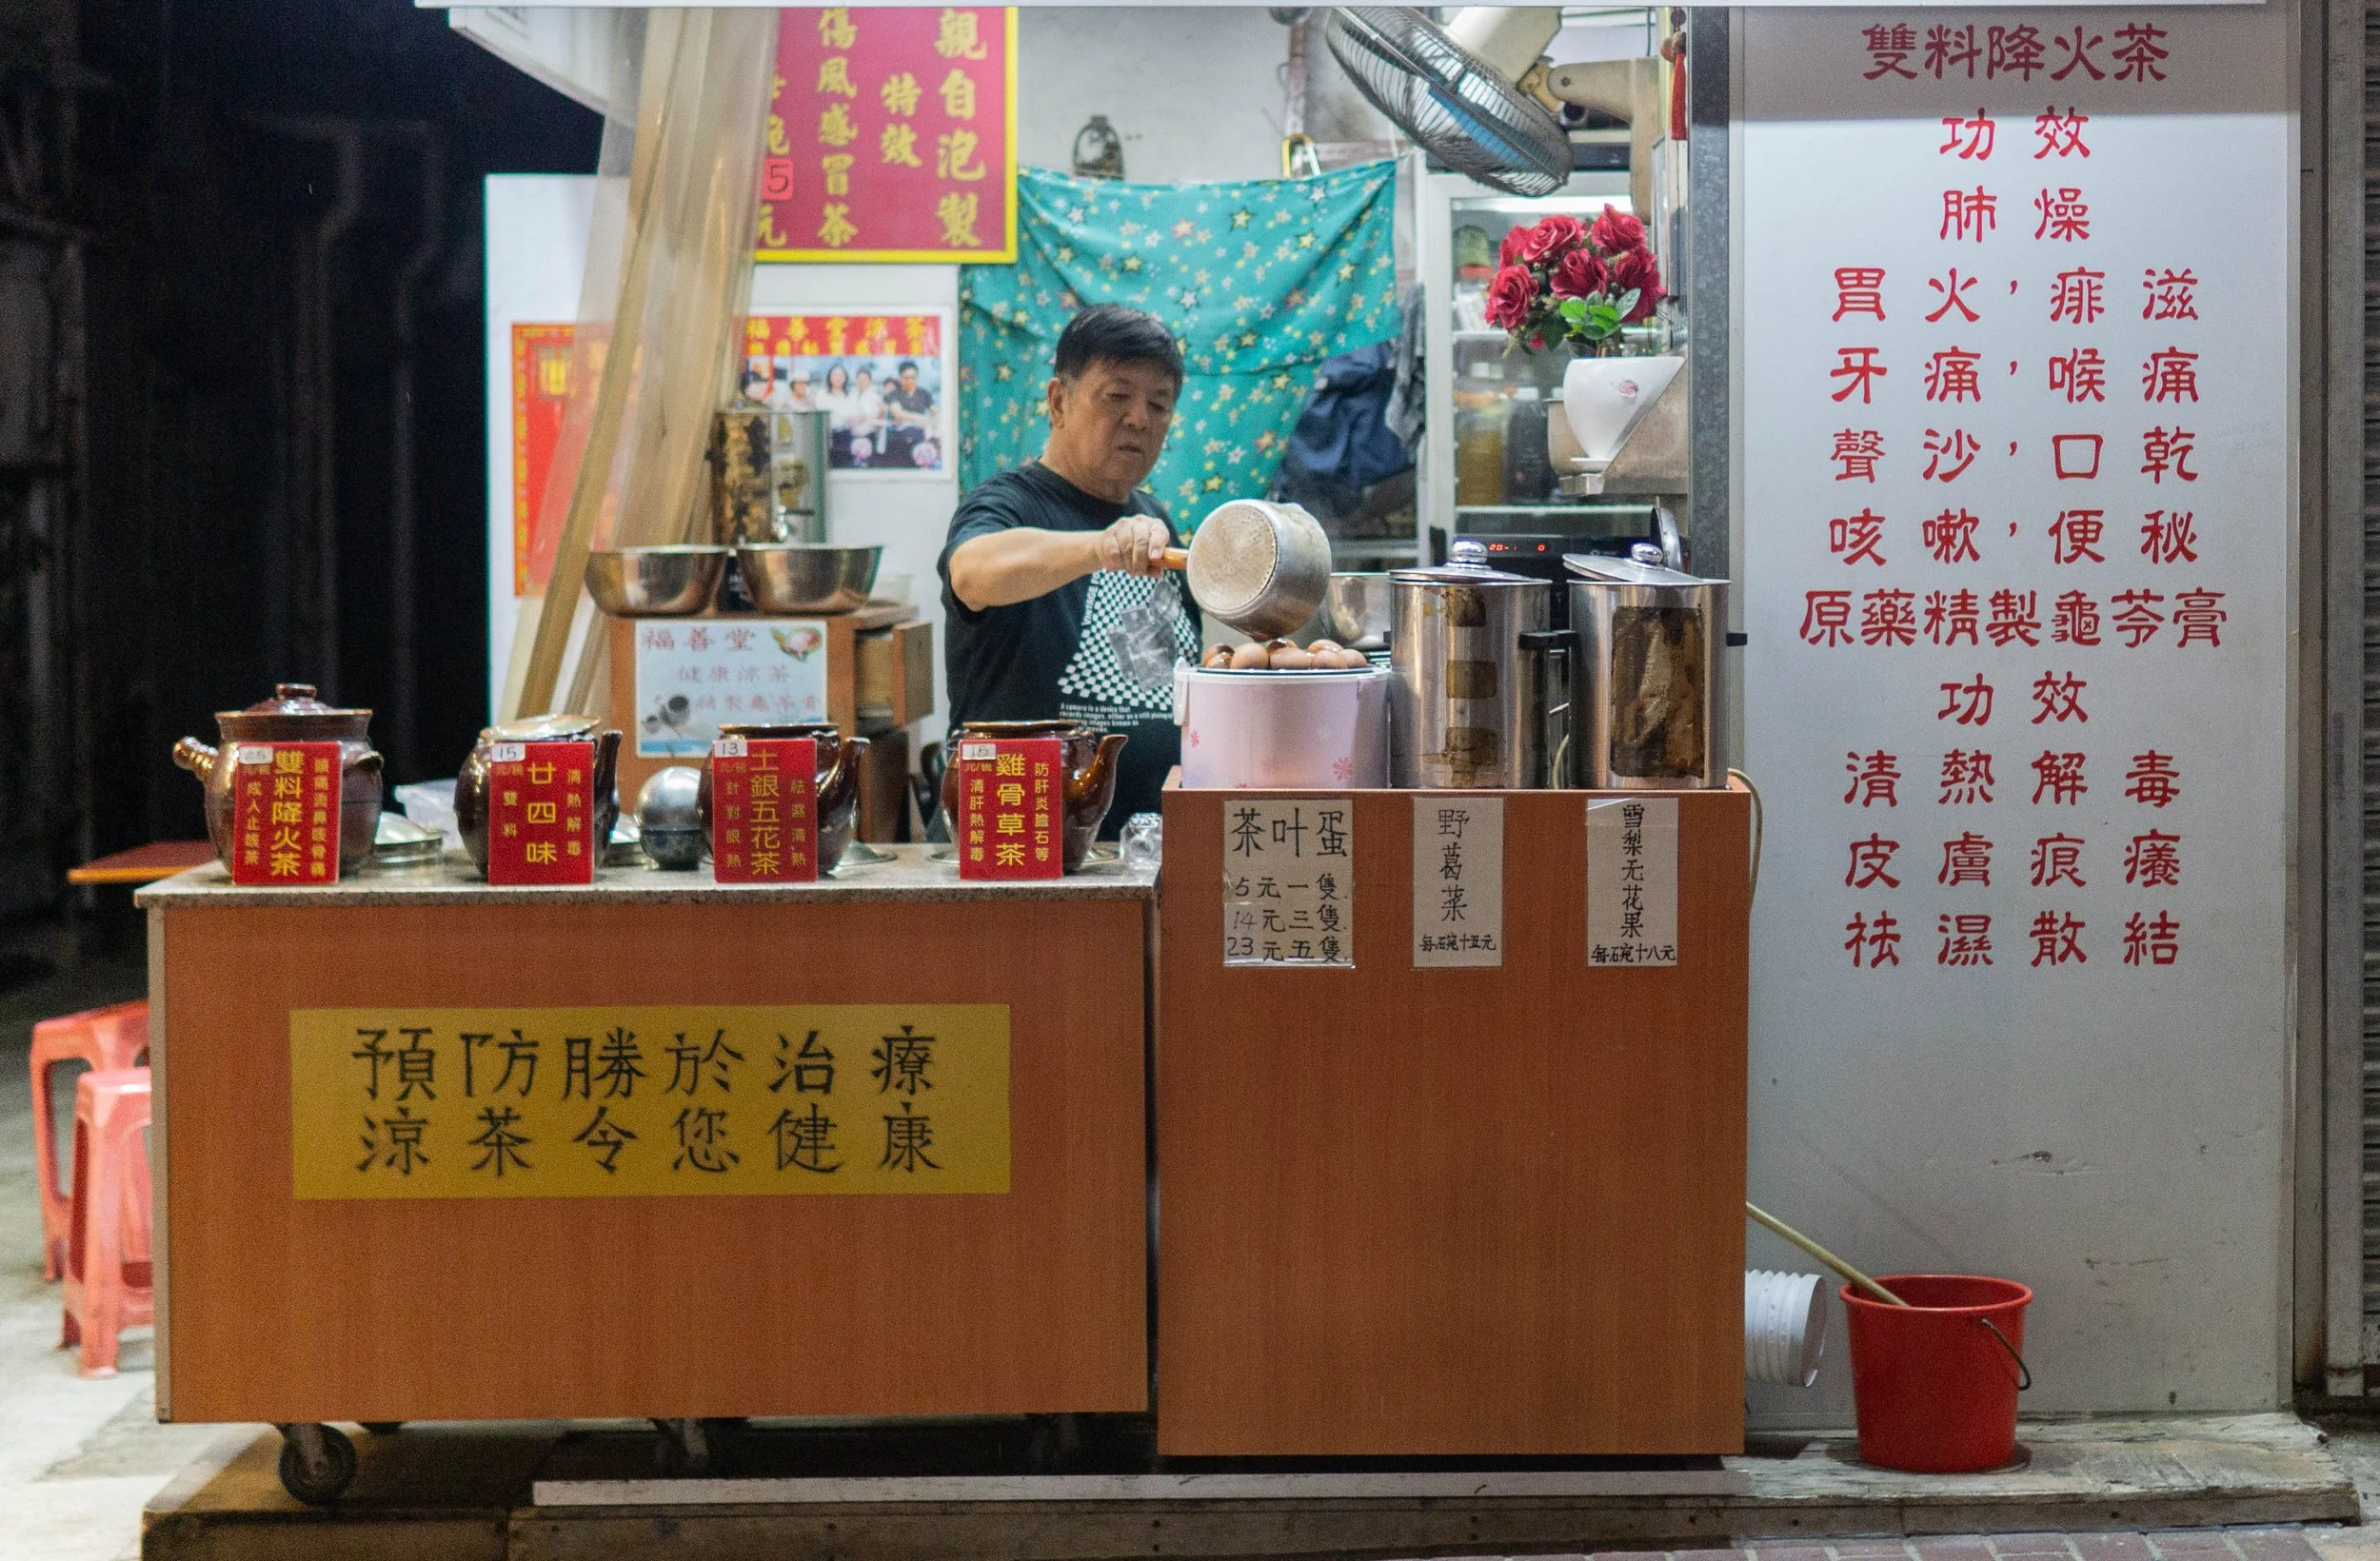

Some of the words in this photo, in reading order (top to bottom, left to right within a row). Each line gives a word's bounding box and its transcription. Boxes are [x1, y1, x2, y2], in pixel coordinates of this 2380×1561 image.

[1863, 24, 2169, 82] 雙料降火茶
[880, 69, 922, 168] 特效
[933, 9, 987, 248] 親自泡製
[1939, 107, 2091, 161] 功效
[1939, 185, 2091, 243] 肺燥
[1830, 346, 2199, 404] 牙痛，喉痛
[1799, 586, 2227, 648] 原藥精製龜苓膏
[1937, 670, 2089, 726] 功效
[500, 746, 517, 760] 15
[721, 742, 739, 756] 13
[971, 745, 989, 758] 15
[1844, 749, 2181, 808] 清熱解毒
[270, 749, 304, 877] 雙料降火茶
[526, 761, 557, 865] 廿四味
[749, 748, 781, 876] 土銀五花茶
[996, 753, 1026, 867] 雞骨草茶
[1231, 807, 1348, 858] 茶叶蛋
[1438, 808, 1470, 922] 野葛菜
[1845, 828, 2182, 888] 皮膚痕癢
[1844, 910, 2180, 968] 祛濕散結
[351, 1023, 939, 1101] 預防勝於治療
[354, 1100, 942, 1177] 涼茶令您健康
